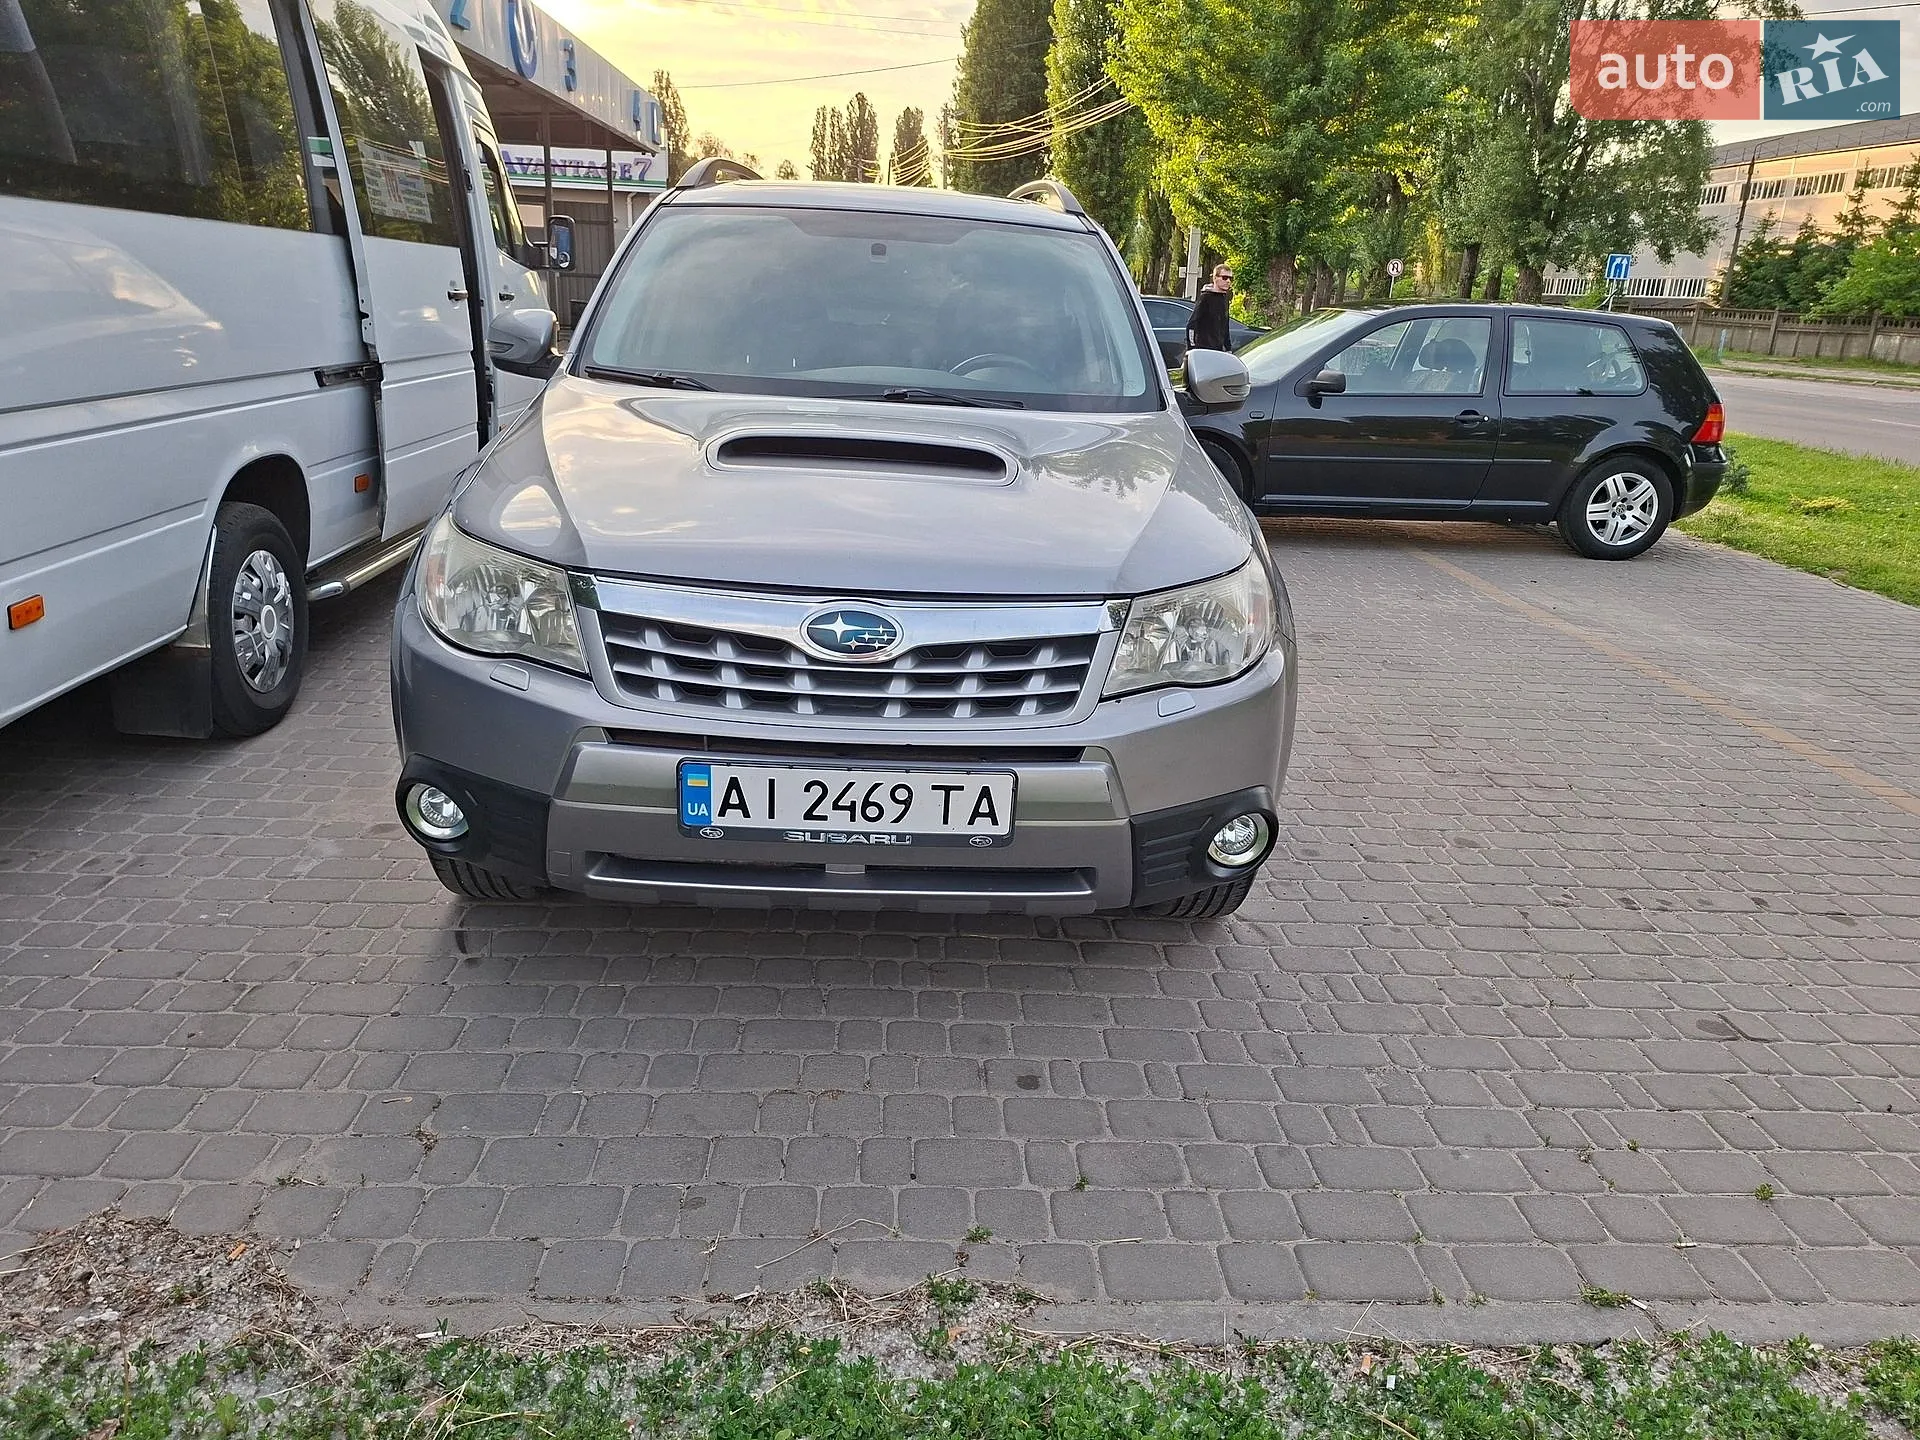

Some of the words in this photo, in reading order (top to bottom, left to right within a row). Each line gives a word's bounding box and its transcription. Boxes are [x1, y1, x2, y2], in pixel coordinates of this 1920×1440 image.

[717, 776, 776, 820] AI
[803, 779, 914, 824] 2469
[930, 784, 1000, 827] TA
[687, 803, 709, 816] UA
[783, 830, 913, 845] SUBARU
